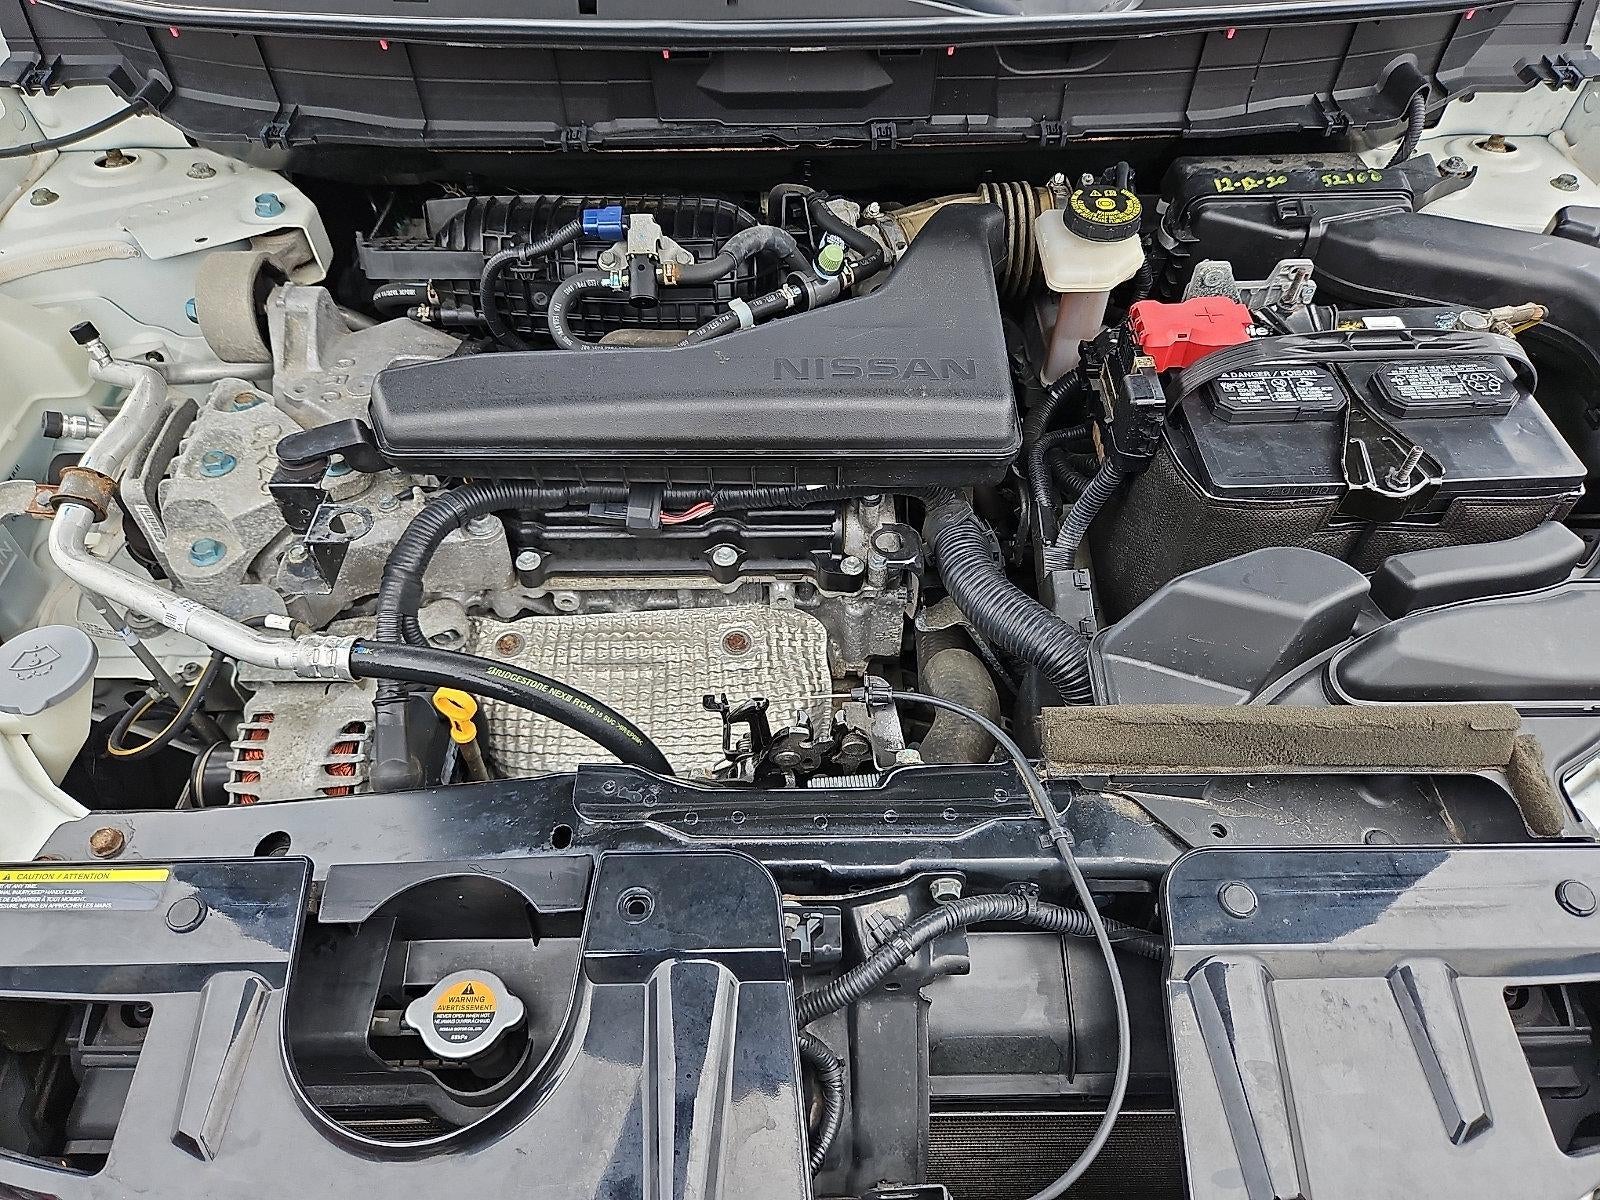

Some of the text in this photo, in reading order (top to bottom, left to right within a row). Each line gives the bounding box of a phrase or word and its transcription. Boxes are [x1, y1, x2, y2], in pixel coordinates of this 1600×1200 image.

[773, 357, 978, 381] NISSAN
[486, 667, 549, 692] BRIDGESTONE
[448, 996, 485, 1004] WARNING
